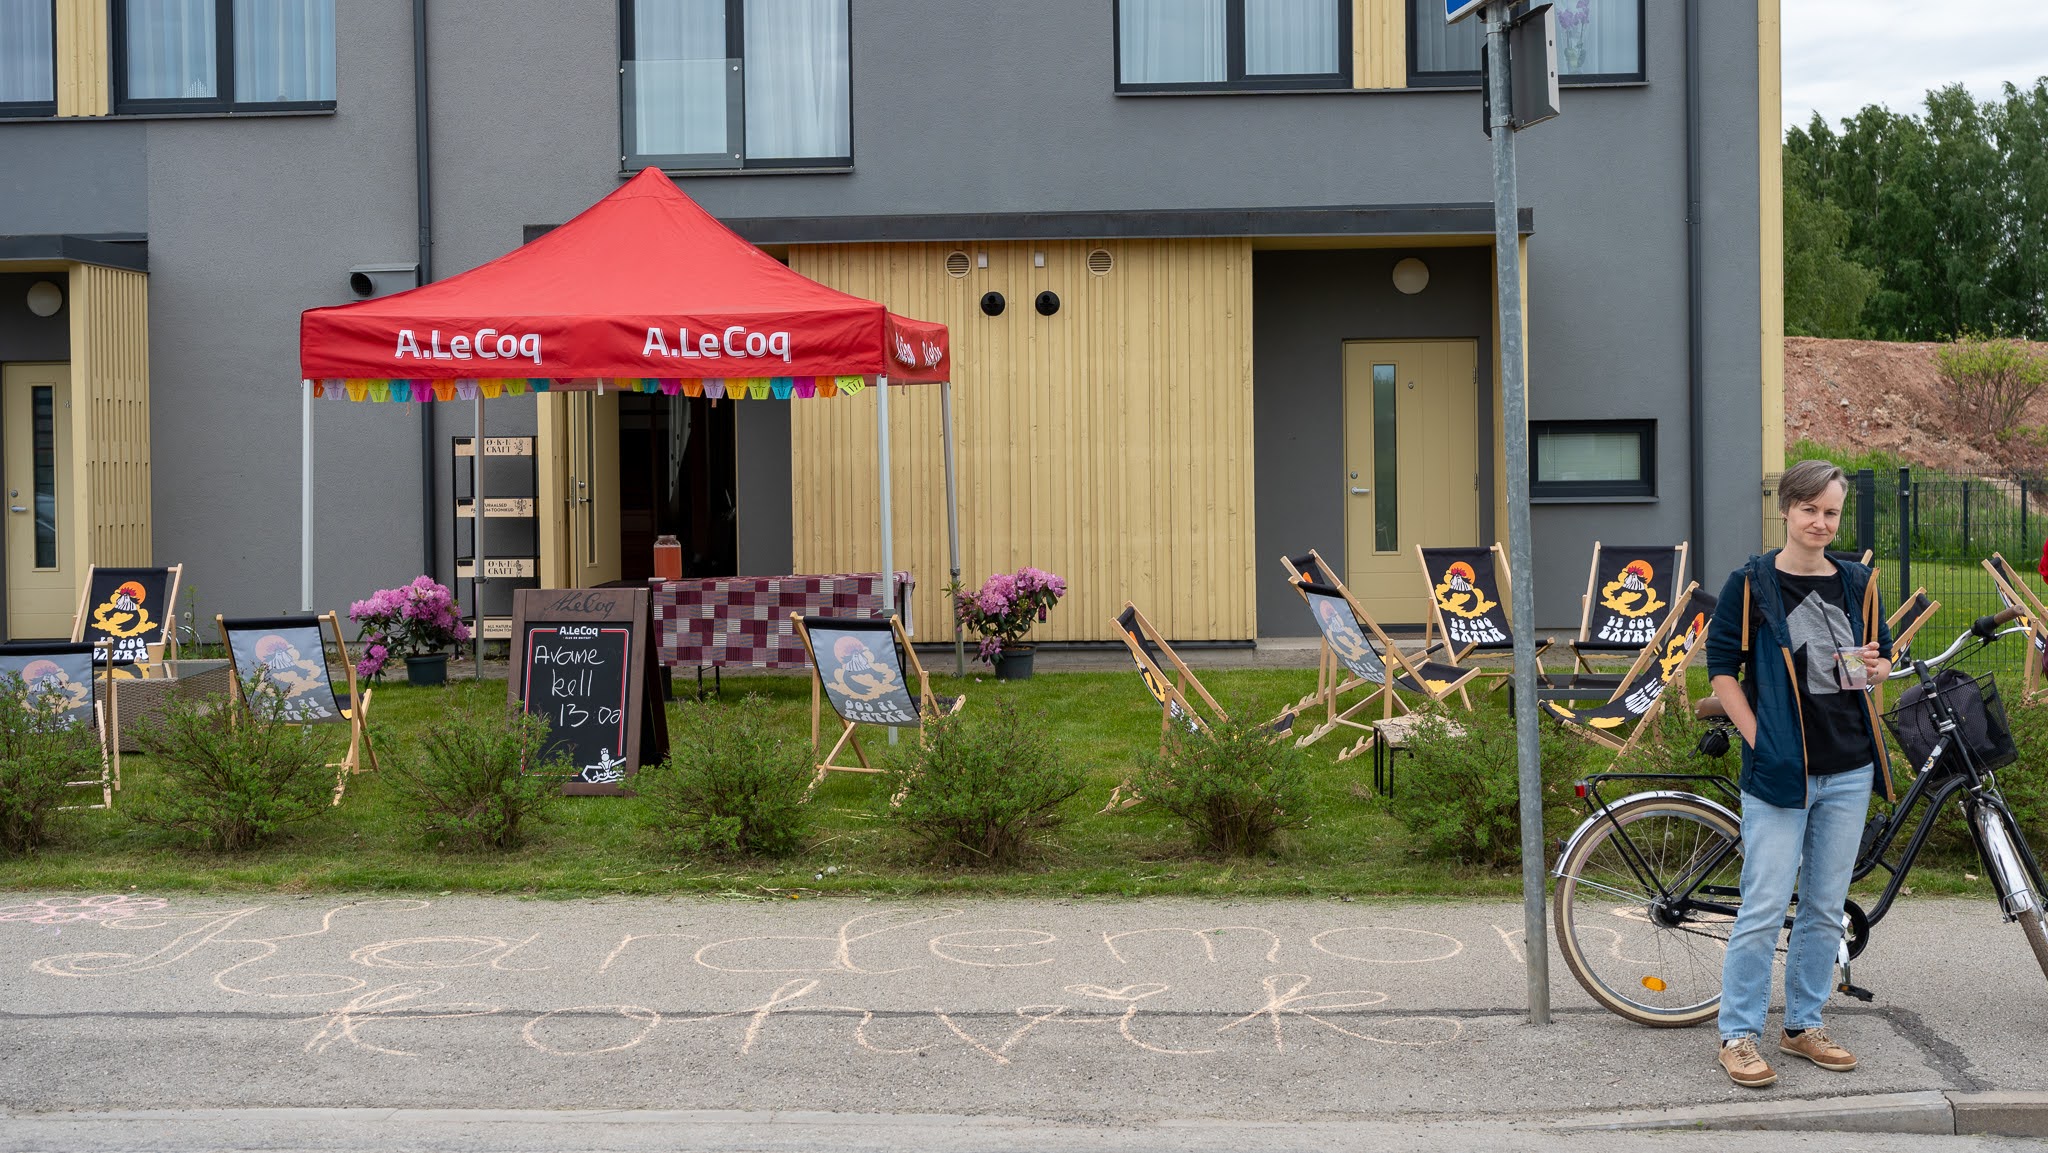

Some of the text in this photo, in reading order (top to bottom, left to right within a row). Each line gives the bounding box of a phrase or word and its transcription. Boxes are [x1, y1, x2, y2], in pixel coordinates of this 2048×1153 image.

[394, 328, 543, 365] A.LeCoq
[642, 326, 792, 363] A.LeCoq
[1450, 617, 1495, 630] LE COQ
[1606, 615, 1654, 630] LE COQ
[559, 626, 599, 638] A.LeCoq
[1450, 627, 1507, 643] EXTRA
[1597, 625, 1656, 643] EXTRA
[534, 645, 605, 666] Avame
[551, 668, 593, 697] kell
